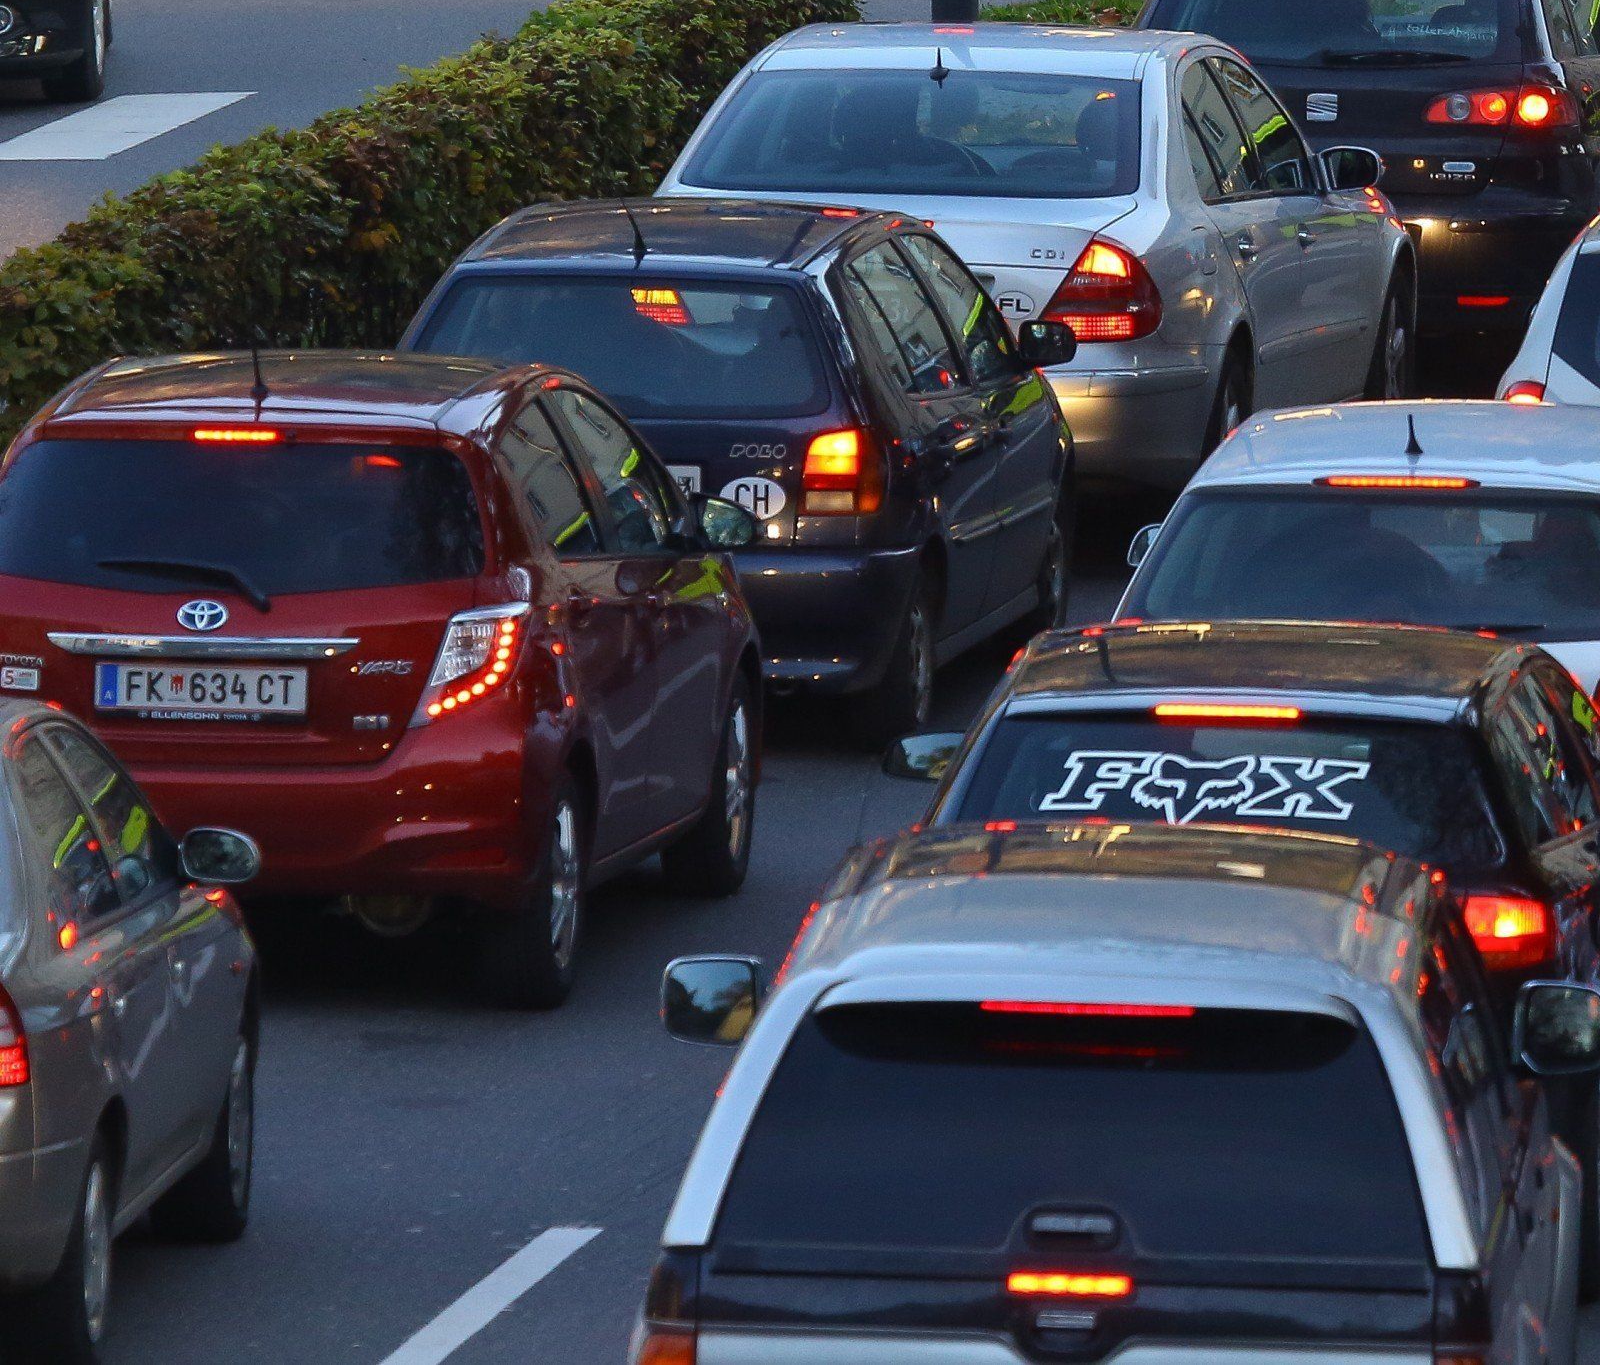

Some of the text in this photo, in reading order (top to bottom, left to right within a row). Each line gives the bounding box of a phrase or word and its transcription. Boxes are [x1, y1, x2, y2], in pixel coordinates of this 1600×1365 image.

[1430, 173, 1476, 181] IBIZA
[1000, 298, 1030, 313] FL
[730, 444, 786, 459] POLO
[4, 670, 14, 685] 5
[126, 671, 164, 703] FK
[189, 673, 246, 705] 634
[256, 674, 294, 705] CT
[151, 711, 210, 720] ELLENSOHN
